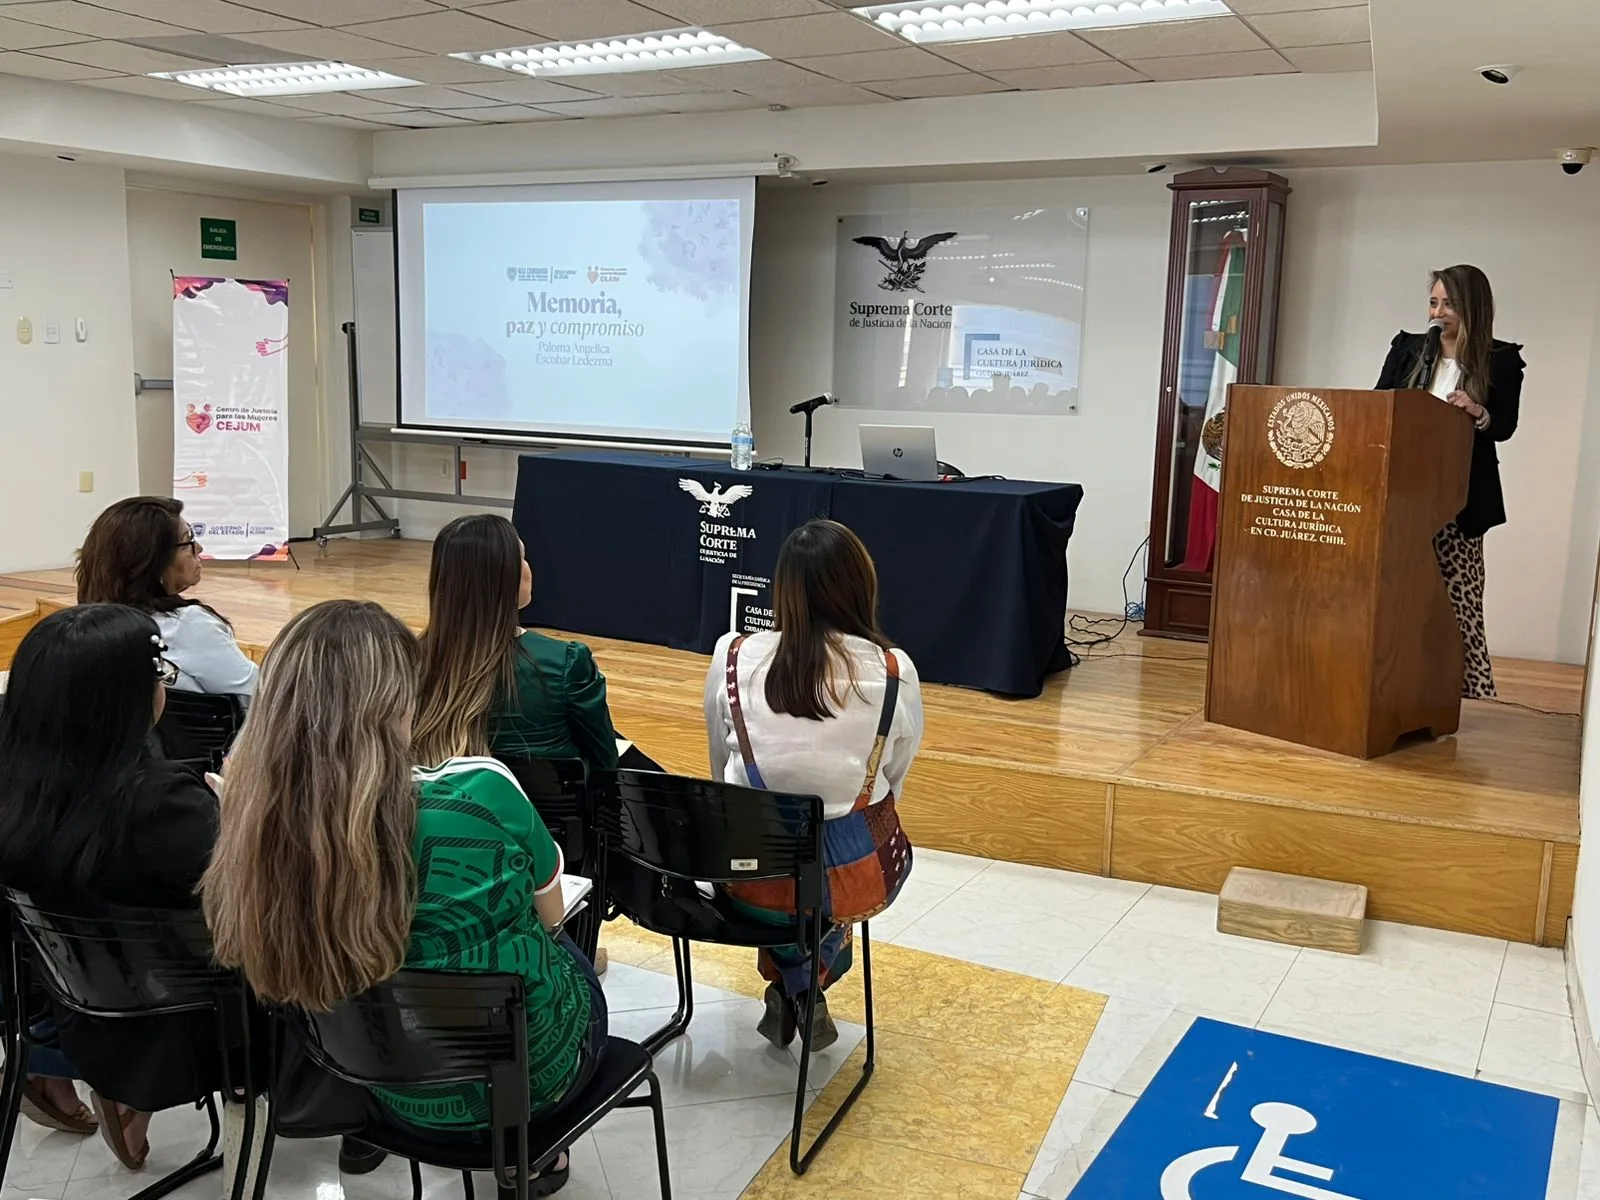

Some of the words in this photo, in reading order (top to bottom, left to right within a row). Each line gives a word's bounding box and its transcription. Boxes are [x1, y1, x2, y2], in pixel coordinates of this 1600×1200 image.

[527, 291, 622, 318] Memoria,
[849, 301, 910, 317] Suprema
[914, 302, 953, 316] Corte
[505, 320, 535, 338] paz
[535, 320, 547, 339] y
[550, 320, 645, 340] compromiso
[849, 318, 860, 328] de
[861, 318, 895, 329] Justicia
[919, 319, 953, 329] Nación
[538, 341, 571, 353] Paloma
[977, 347, 999, 356] CASA
[1001, 348, 1014, 356] DE
[1015, 348, 1027, 356] LA
[535, 353, 571, 366] Escobar
[572, 355, 613, 367] Ledezma
[976, 359, 1018, 368] CULTURA
[1018, 358, 1063, 369] JURÍDICA
[1267, 399, 1286, 428] ESTADOS
[1285, 391, 1311, 403] UNIDOS
[1311, 394, 1336, 431] MEXICANOS
[216, 421, 261, 432] CEJUM
[1262, 485, 1305, 497] SUPREMA
[1306, 488, 1339, 500] CORTE
[1241, 494, 1253, 503] DE
[1253, 494, 1294, 507] JUSTICIA
[1295, 499, 1308, 508] DE
[1310, 501, 1322, 510] LA
[1323, 501, 1362, 513] NACIÓN
[1272, 507, 1297, 518] CASA
[1297, 510, 1311, 520] DE
[1312, 511, 1325, 521] LA
[700, 520, 757, 539] SUPREMA
[1255, 516, 1297, 529] CULTURA
[1298, 520, 1342, 534] JURÍDICA
[700, 534, 737, 551] CORTE
[1250, 527, 1262, 535] EN
[1263, 528, 1279, 538] CD.
[1319, 534, 1347, 546] CHIH.
[706, 550, 728, 558] JUSTICIA
[745, 605, 762, 616] CASA
[763, 608, 774, 618] DE
[744, 616, 776, 628] CULTURA
